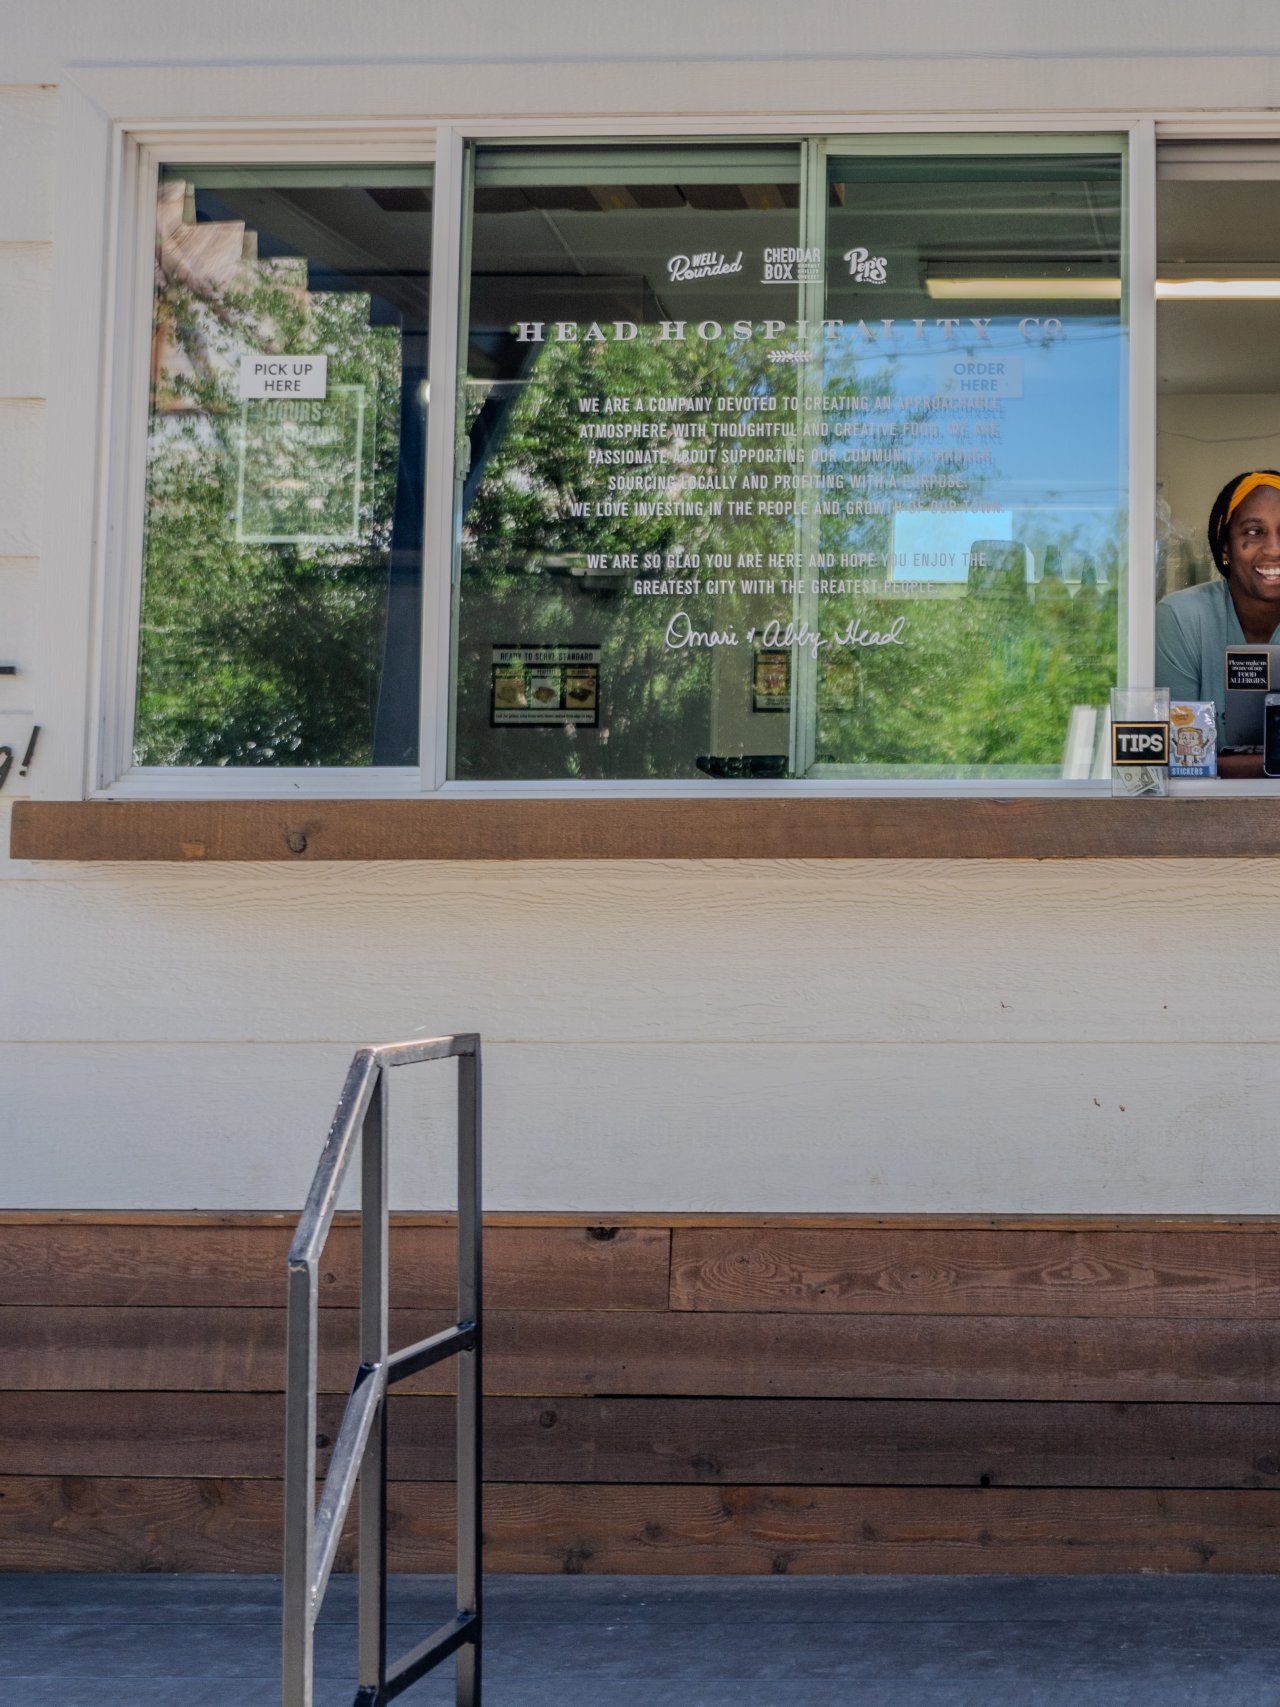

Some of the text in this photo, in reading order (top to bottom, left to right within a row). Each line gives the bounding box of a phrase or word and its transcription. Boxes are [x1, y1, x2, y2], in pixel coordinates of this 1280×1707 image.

[692, 252, 717, 267] WELL
[764, 248, 821, 263] CHEDDAR
[668, 251, 743, 282] Rounded
[764, 263, 793, 280] BOX
[515, 320, 639, 343] HEAD
[659, 318, 993, 342] HOSPITALITY
[255, 364, 313, 376] PICK UP
[953, 363, 1006, 376] ORDER
[264, 380, 302, 392] HERE
[960, 379, 998, 391] HERE
[579, 396, 891, 412] WE ARE A COMPANY DEVOTED TO CREATING AN
[587, 553, 986, 569] WE ARE SO GLAD YOU ARE HERE AND HOPE YOU ENJOY THE
[634, 580, 701, 595] GREATEST
[707, 580, 735, 594] CITY
[741, 580, 774, 594] WITH
[781, 580, 805, 594] THE
[812, 579, 877, 594] GREATEST
[666, 611, 906, 659] Omari Abby Head
[1118, 734, 1163, 752] TIPS
[1172, 767, 1203, 776] STICKERS
